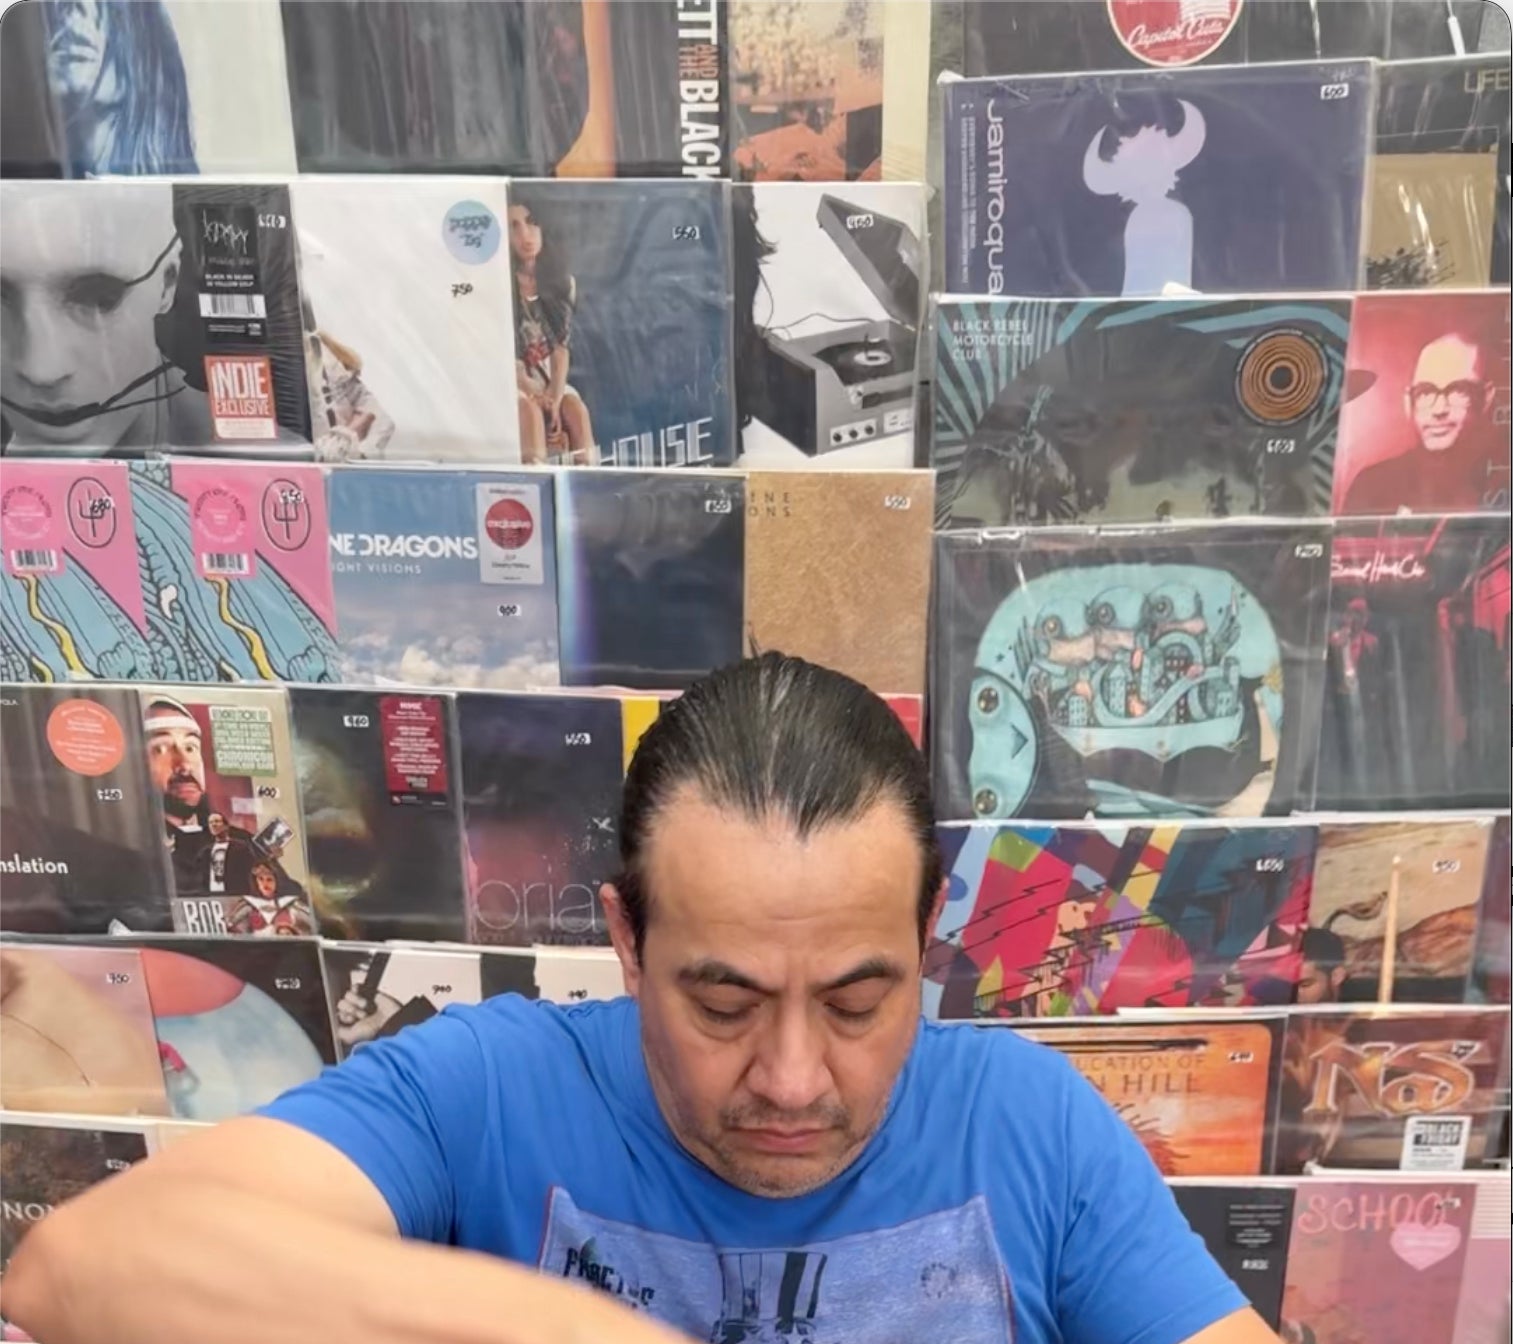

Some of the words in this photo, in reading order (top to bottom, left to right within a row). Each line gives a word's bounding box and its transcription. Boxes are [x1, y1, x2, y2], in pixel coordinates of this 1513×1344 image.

[451, 283, 473, 298] 750
[954, 334, 1034, 346] MOTORCYCLE
[211, 362, 269, 399] INDIE
[216, 401, 270, 415] EXCLUSIVE
[358, 534, 478, 559] DRAGONS
[367, 563, 422, 574] VISIONS
[0, 853, 68, 874] nslation
[1122, 1072, 1204, 1096] HILL
